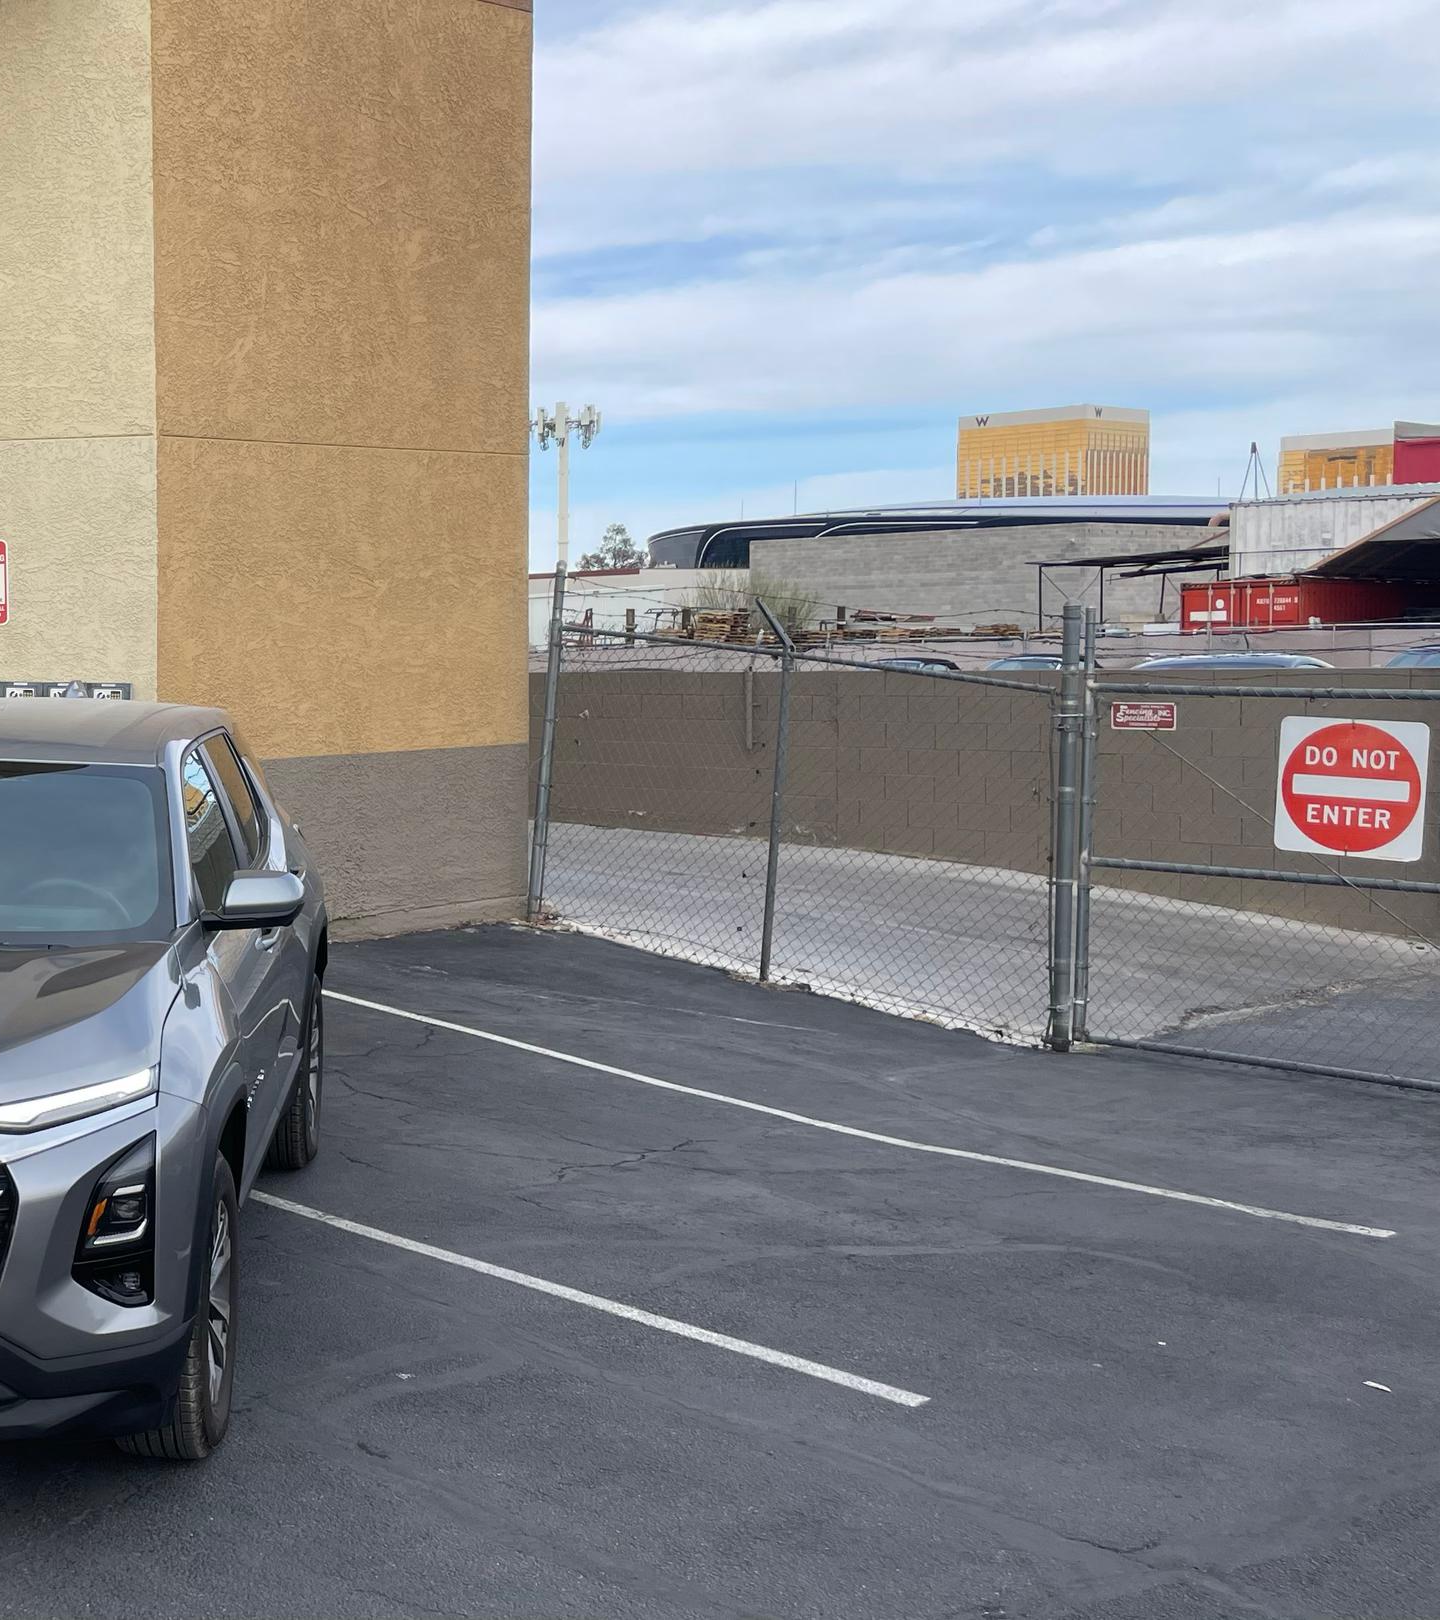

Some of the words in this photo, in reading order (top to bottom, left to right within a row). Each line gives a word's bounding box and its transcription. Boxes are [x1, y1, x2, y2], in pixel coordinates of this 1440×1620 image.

[1094, 407, 1103, 418] W
[975, 416, 990, 427] W
[1120, 705, 1153, 715] Fencing
[1305, 746, 1338, 766] DO
[1352, 749, 1400, 770] NOT
[1306, 803, 1391, 830] ENTER
